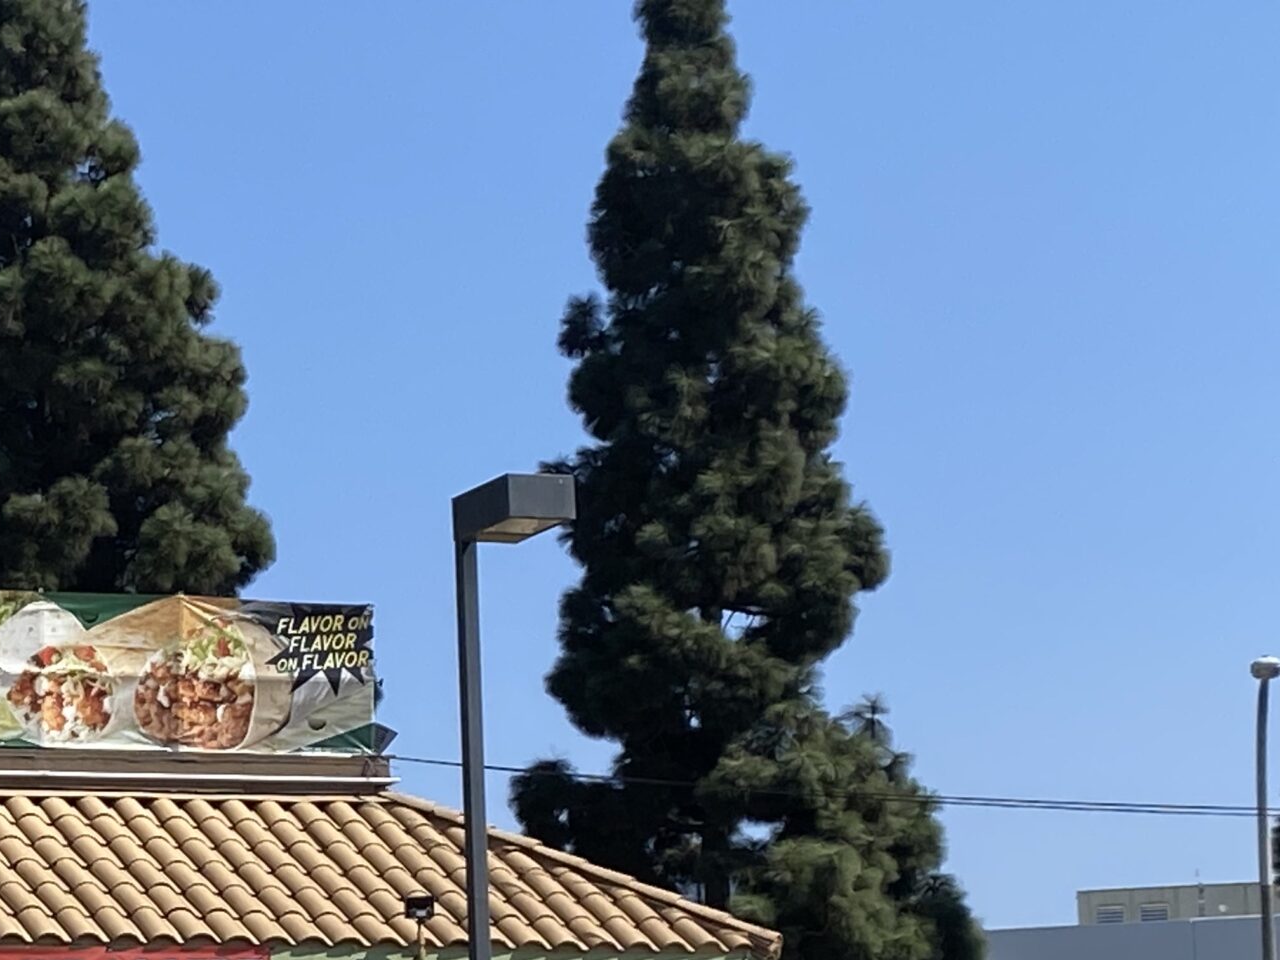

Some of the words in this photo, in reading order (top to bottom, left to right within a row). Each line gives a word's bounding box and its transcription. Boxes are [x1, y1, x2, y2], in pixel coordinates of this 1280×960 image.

[276, 615, 344, 635] FLAVOR
[348, 615, 370, 630] ON
[288, 634, 356, 652] FLAVOR
[276, 658, 297, 673] ON
[299, 650, 369, 671] FLAVOR
